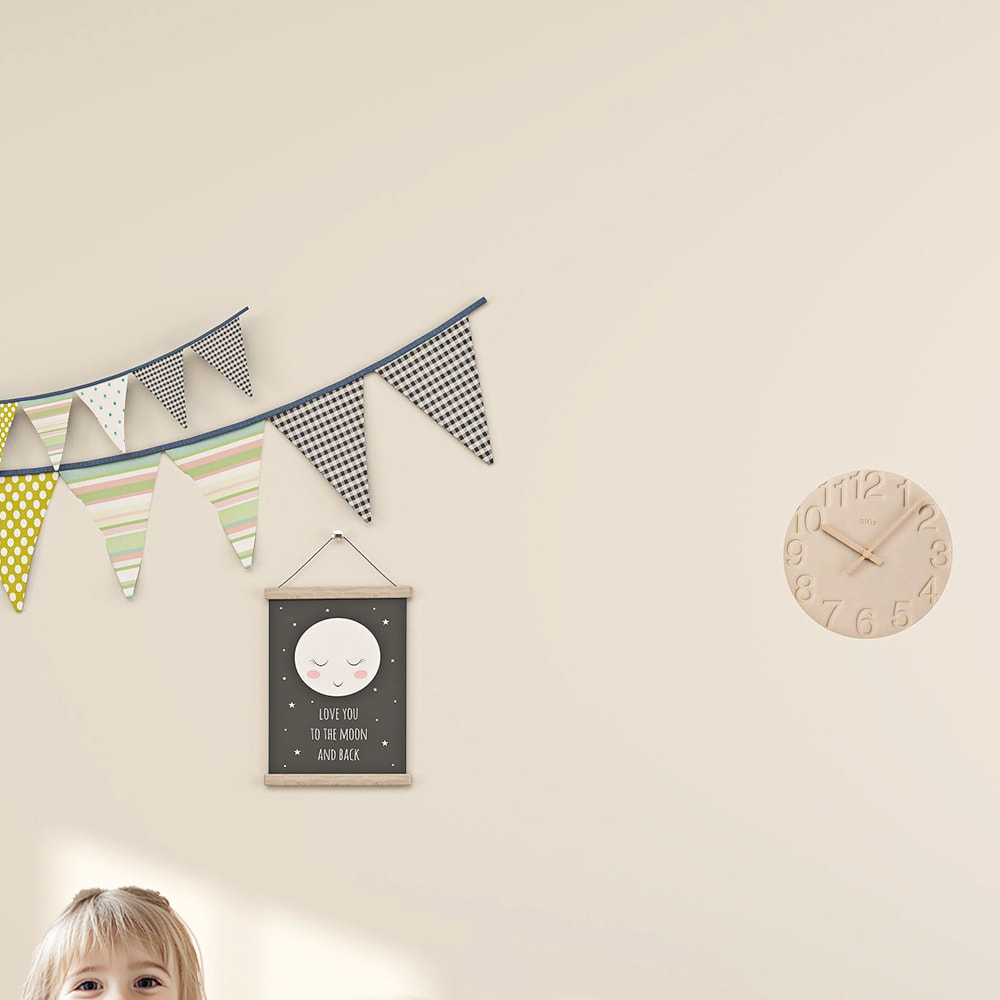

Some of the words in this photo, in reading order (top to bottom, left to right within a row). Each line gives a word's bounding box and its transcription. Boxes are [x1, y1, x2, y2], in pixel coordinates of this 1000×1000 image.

[818, 479, 845, 507] 11
[849, 471, 883, 499] 12
[897, 479, 908, 507] 1
[795, 505, 822, 534] 10
[917, 503, 937, 532] 2
[786, 539, 803, 566] 9
[929, 539, 947, 568] 3
[794, 574, 812, 601] 8
[918, 575, 938, 604] 4
[822, 600, 843, 628] 7
[855, 607, 873, 635] 6
[891, 601, 911, 629] 5
[319, 708, 340, 720] LOVE
[342, 708, 359, 720] YOU
[310, 728, 320, 740] TO
[323, 728, 337, 740] THE
[339, 728, 368, 741] MOON
[318, 748, 336, 761] AND
[339, 748, 360, 761] BACK
